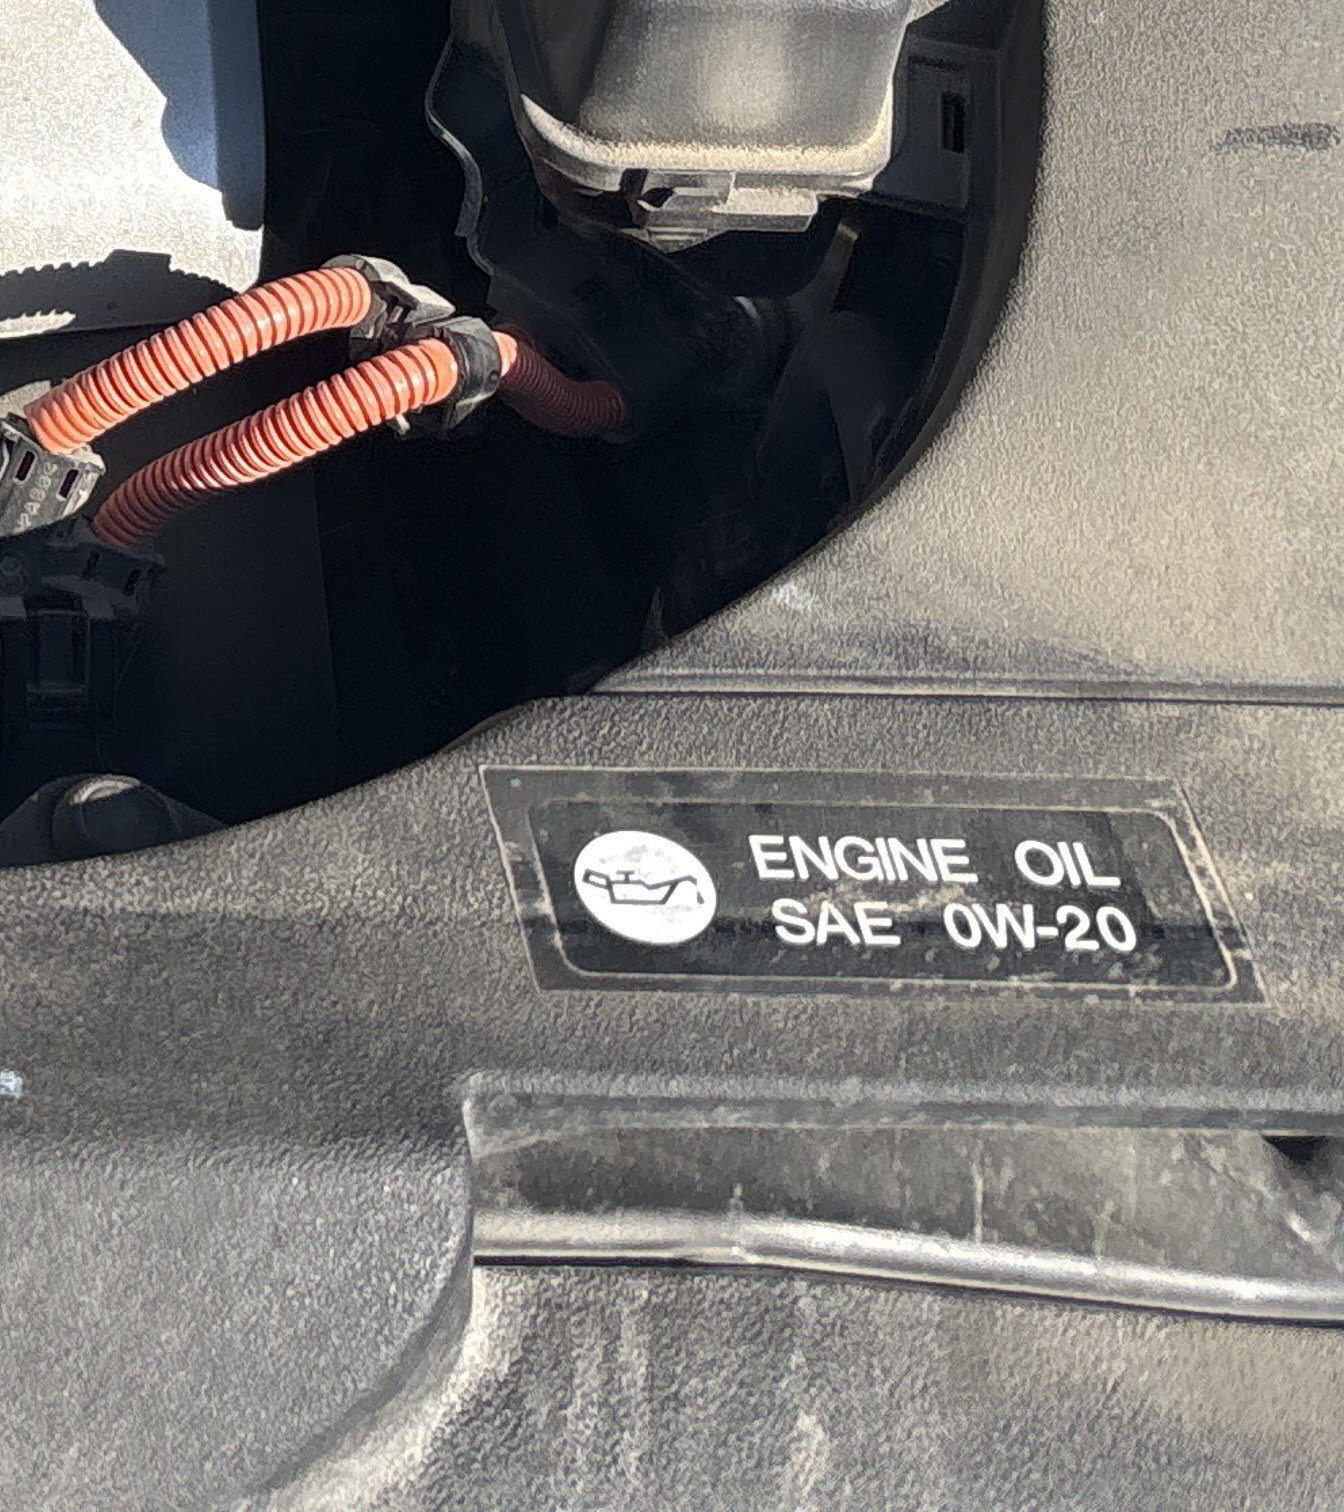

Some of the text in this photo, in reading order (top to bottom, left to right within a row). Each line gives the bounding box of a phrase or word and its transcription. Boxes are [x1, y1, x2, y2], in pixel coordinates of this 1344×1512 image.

[748, 834, 1121, 887] ENGINE OIL
[771, 898, 1137, 952] SAE 0W-20
